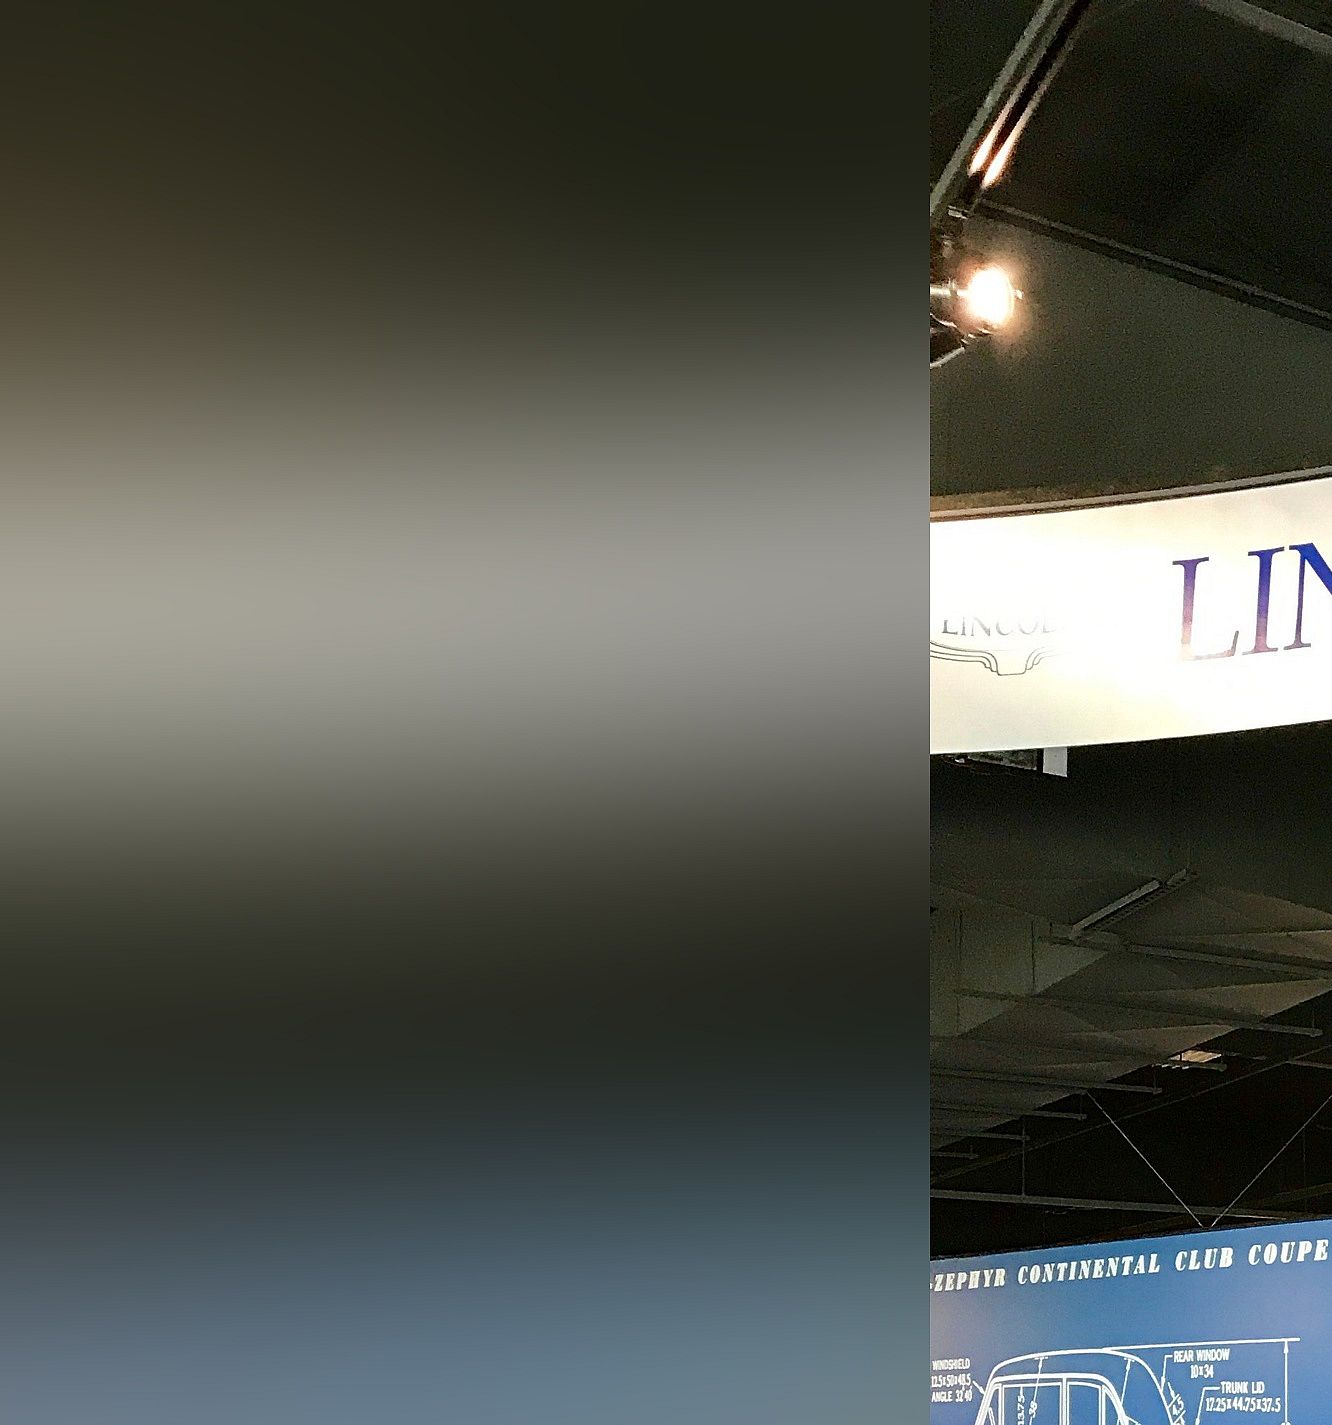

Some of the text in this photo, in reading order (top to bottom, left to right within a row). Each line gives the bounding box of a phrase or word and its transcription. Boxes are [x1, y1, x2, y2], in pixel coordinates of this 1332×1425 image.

[1018, 1255, 1161, 1286] CONTINENTAL
[1175, 1246, 1234, 1272] CLUB
[1248, 1238, 1329, 1266] COUPE
[1173, 1348, 1230, 1363] REAR WINDOW
[1220, 1381, 1265, 1394] TRUNK LID
[932, 1390, 953, 1402] ANGLE
